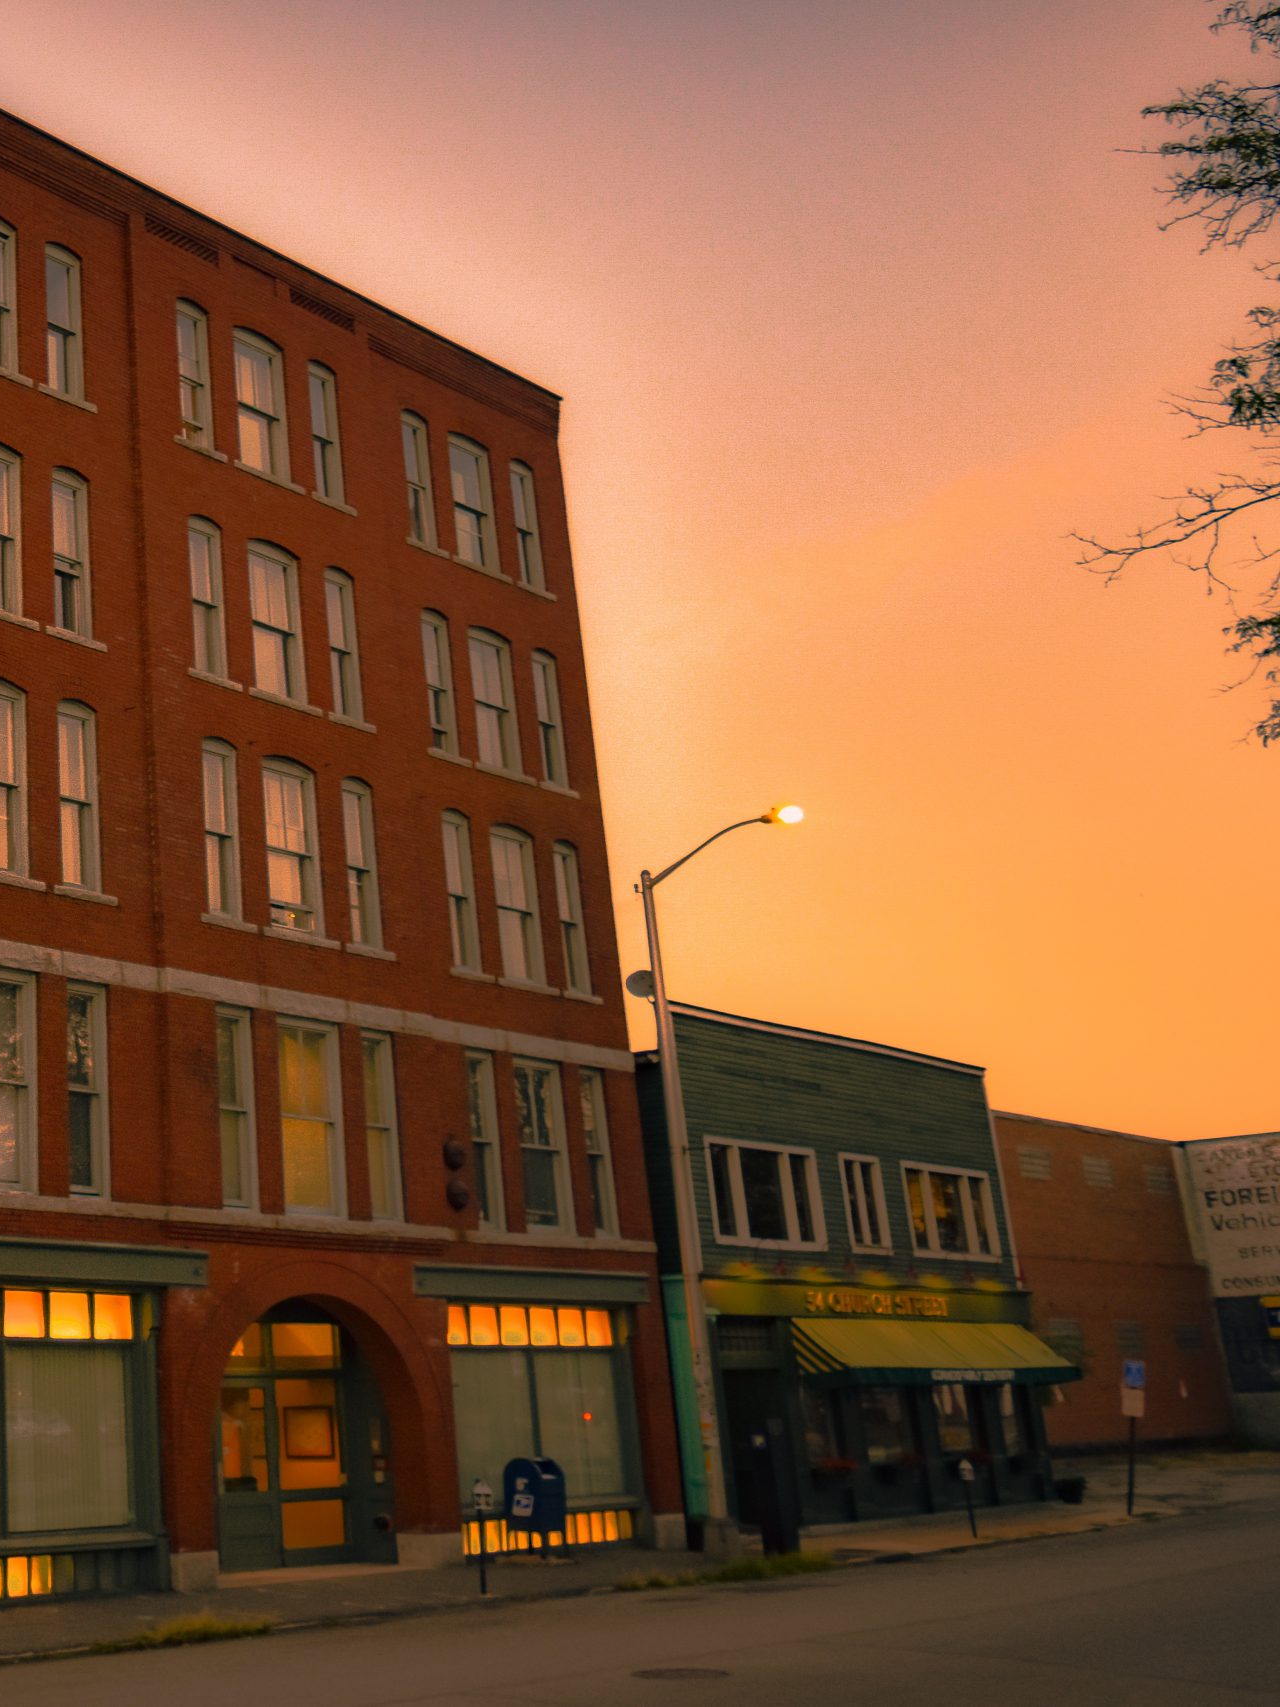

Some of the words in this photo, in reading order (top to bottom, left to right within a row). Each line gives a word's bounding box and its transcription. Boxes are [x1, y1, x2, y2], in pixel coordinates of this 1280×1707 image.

[807, 1290, 824, 1312] 54
[828, 1292, 892, 1315] CHURCH
[894, 1295, 949, 1317] STREET
